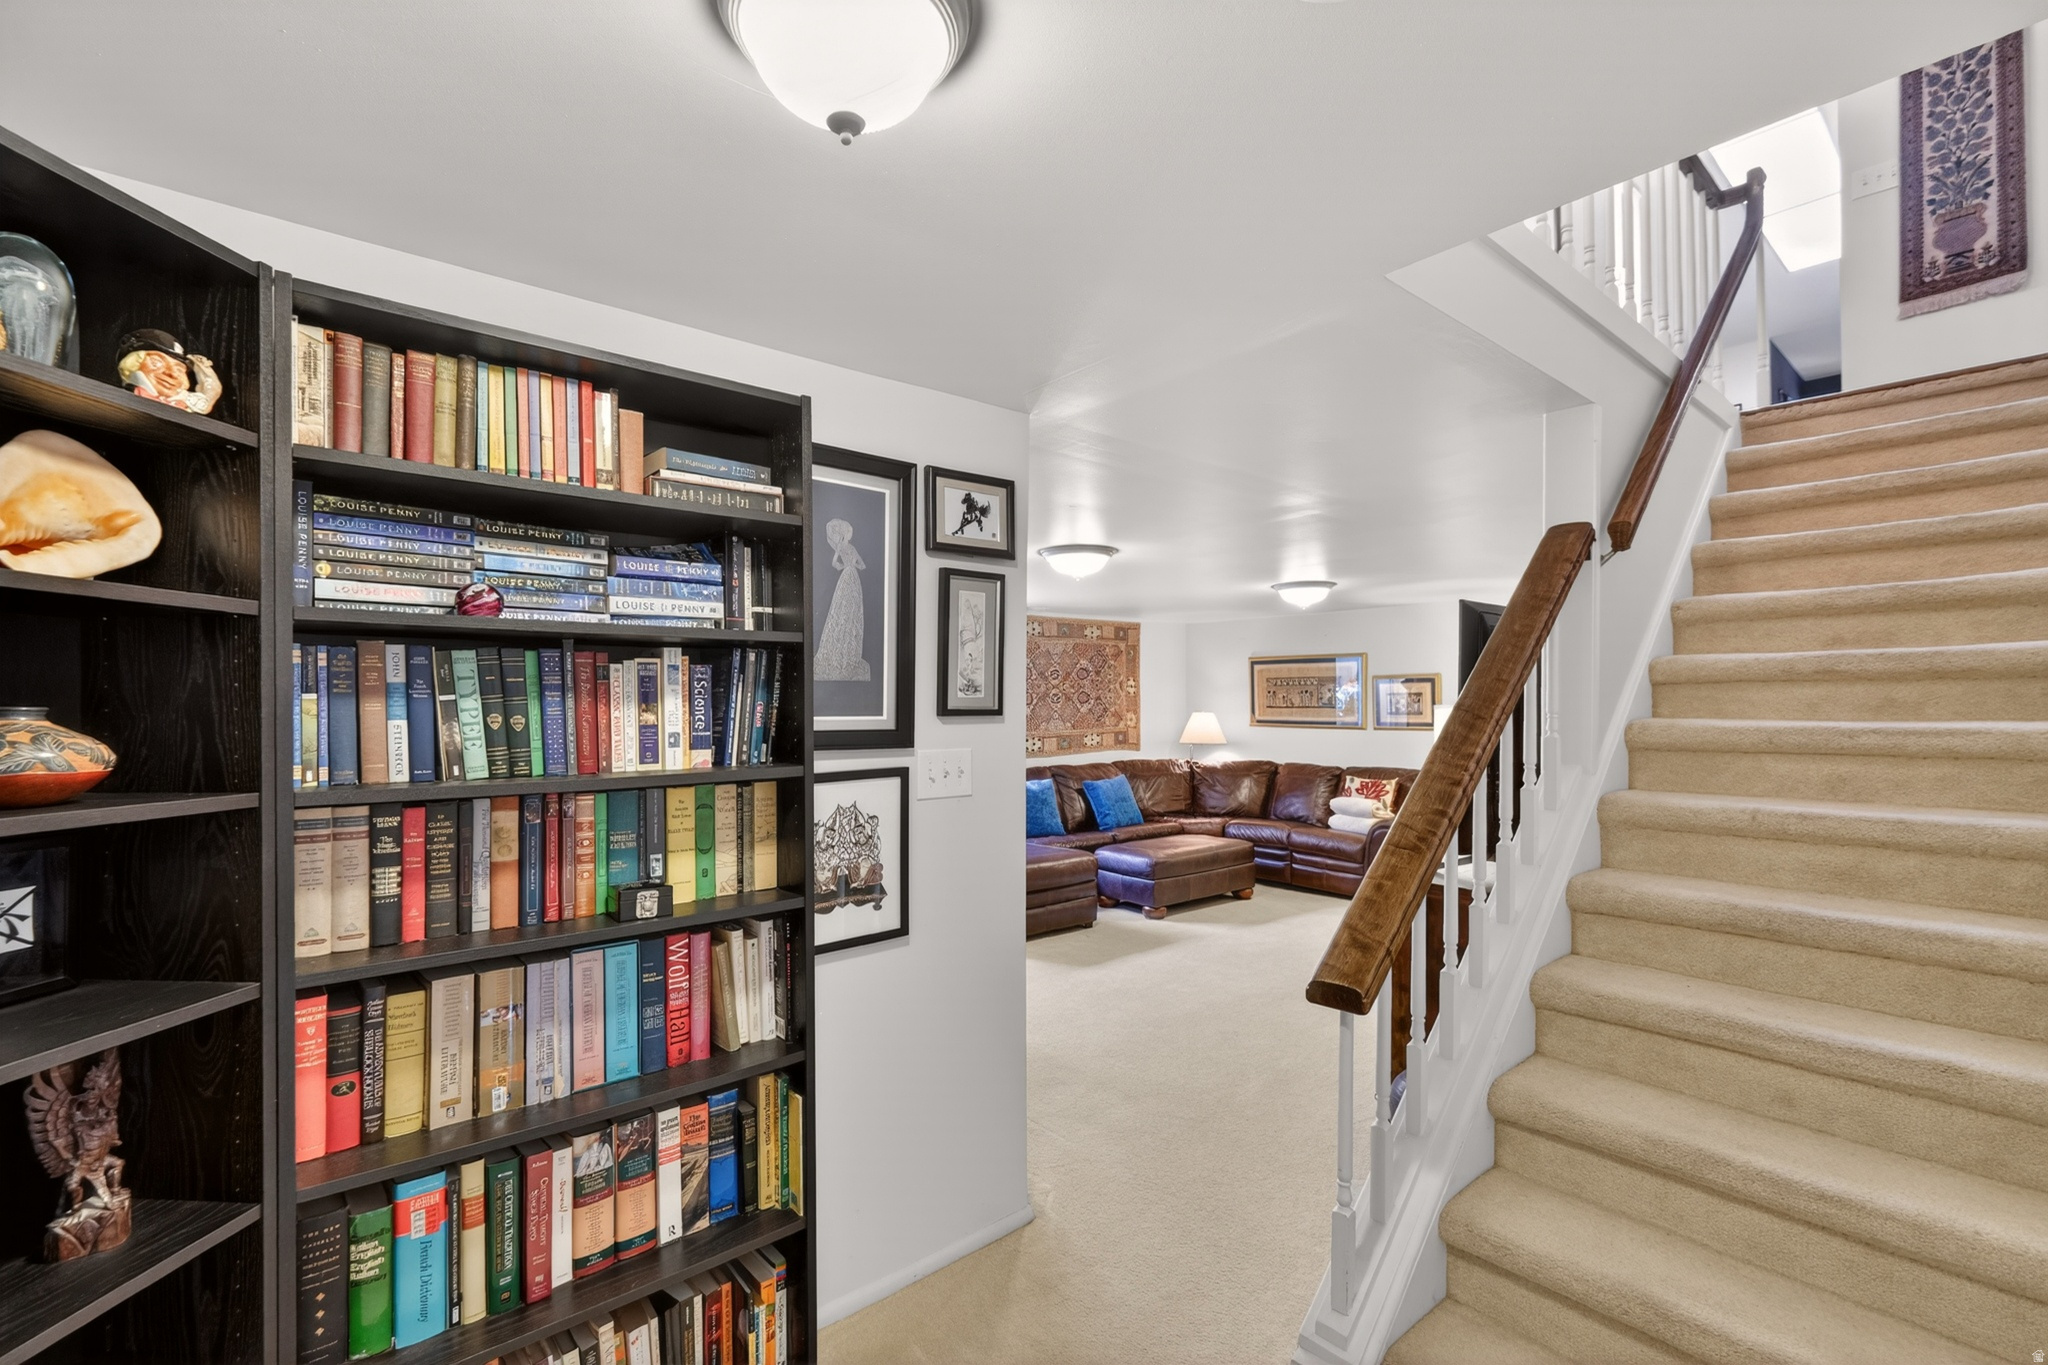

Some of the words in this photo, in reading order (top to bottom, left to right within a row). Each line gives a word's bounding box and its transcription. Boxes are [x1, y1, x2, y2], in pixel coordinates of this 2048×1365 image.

[298, 491, 307, 529] LOUISE
[329, 500, 379, 513] LOUISE
[380, 506, 421, 518] PENNY
[329, 519, 379, 530] LOUISE
[380, 523, 420, 535] PENNY
[486, 524, 525, 536] LOUISE
[528, 529, 564, 541] PENNY
[298, 533, 307, 570] PENNY
[329, 533, 377, 545] LOUISE
[379, 539, 420, 550] PENNY
[329, 548, 377, 561] LOUISE
[379, 554, 420, 564] PENNY
[336, 566, 383, 576] LOUISE
[386, 571, 427, 580] PENNY
[623, 560, 660, 572] LOUISE
[676, 564, 709, 576] PENNY
[334, 585, 381, 596] LOUISE
[485, 576, 524, 586] LOUISE
[526, 579, 561, 590] PENNY
[615, 600, 655, 611] LOUISE
[671, 603, 705, 614] PENNY
[391, 652, 402, 678] JOHN
[457, 668, 482, 751] TYPEE
[694, 680, 708, 729] Science
[393, 724, 404, 776] STEINBECK
[668, 938, 690, 989] Wolf
[669, 1006, 690, 1046] Hall
[420, 1239, 432, 1273] French
[417, 1273, 433, 1323] Dictionary
